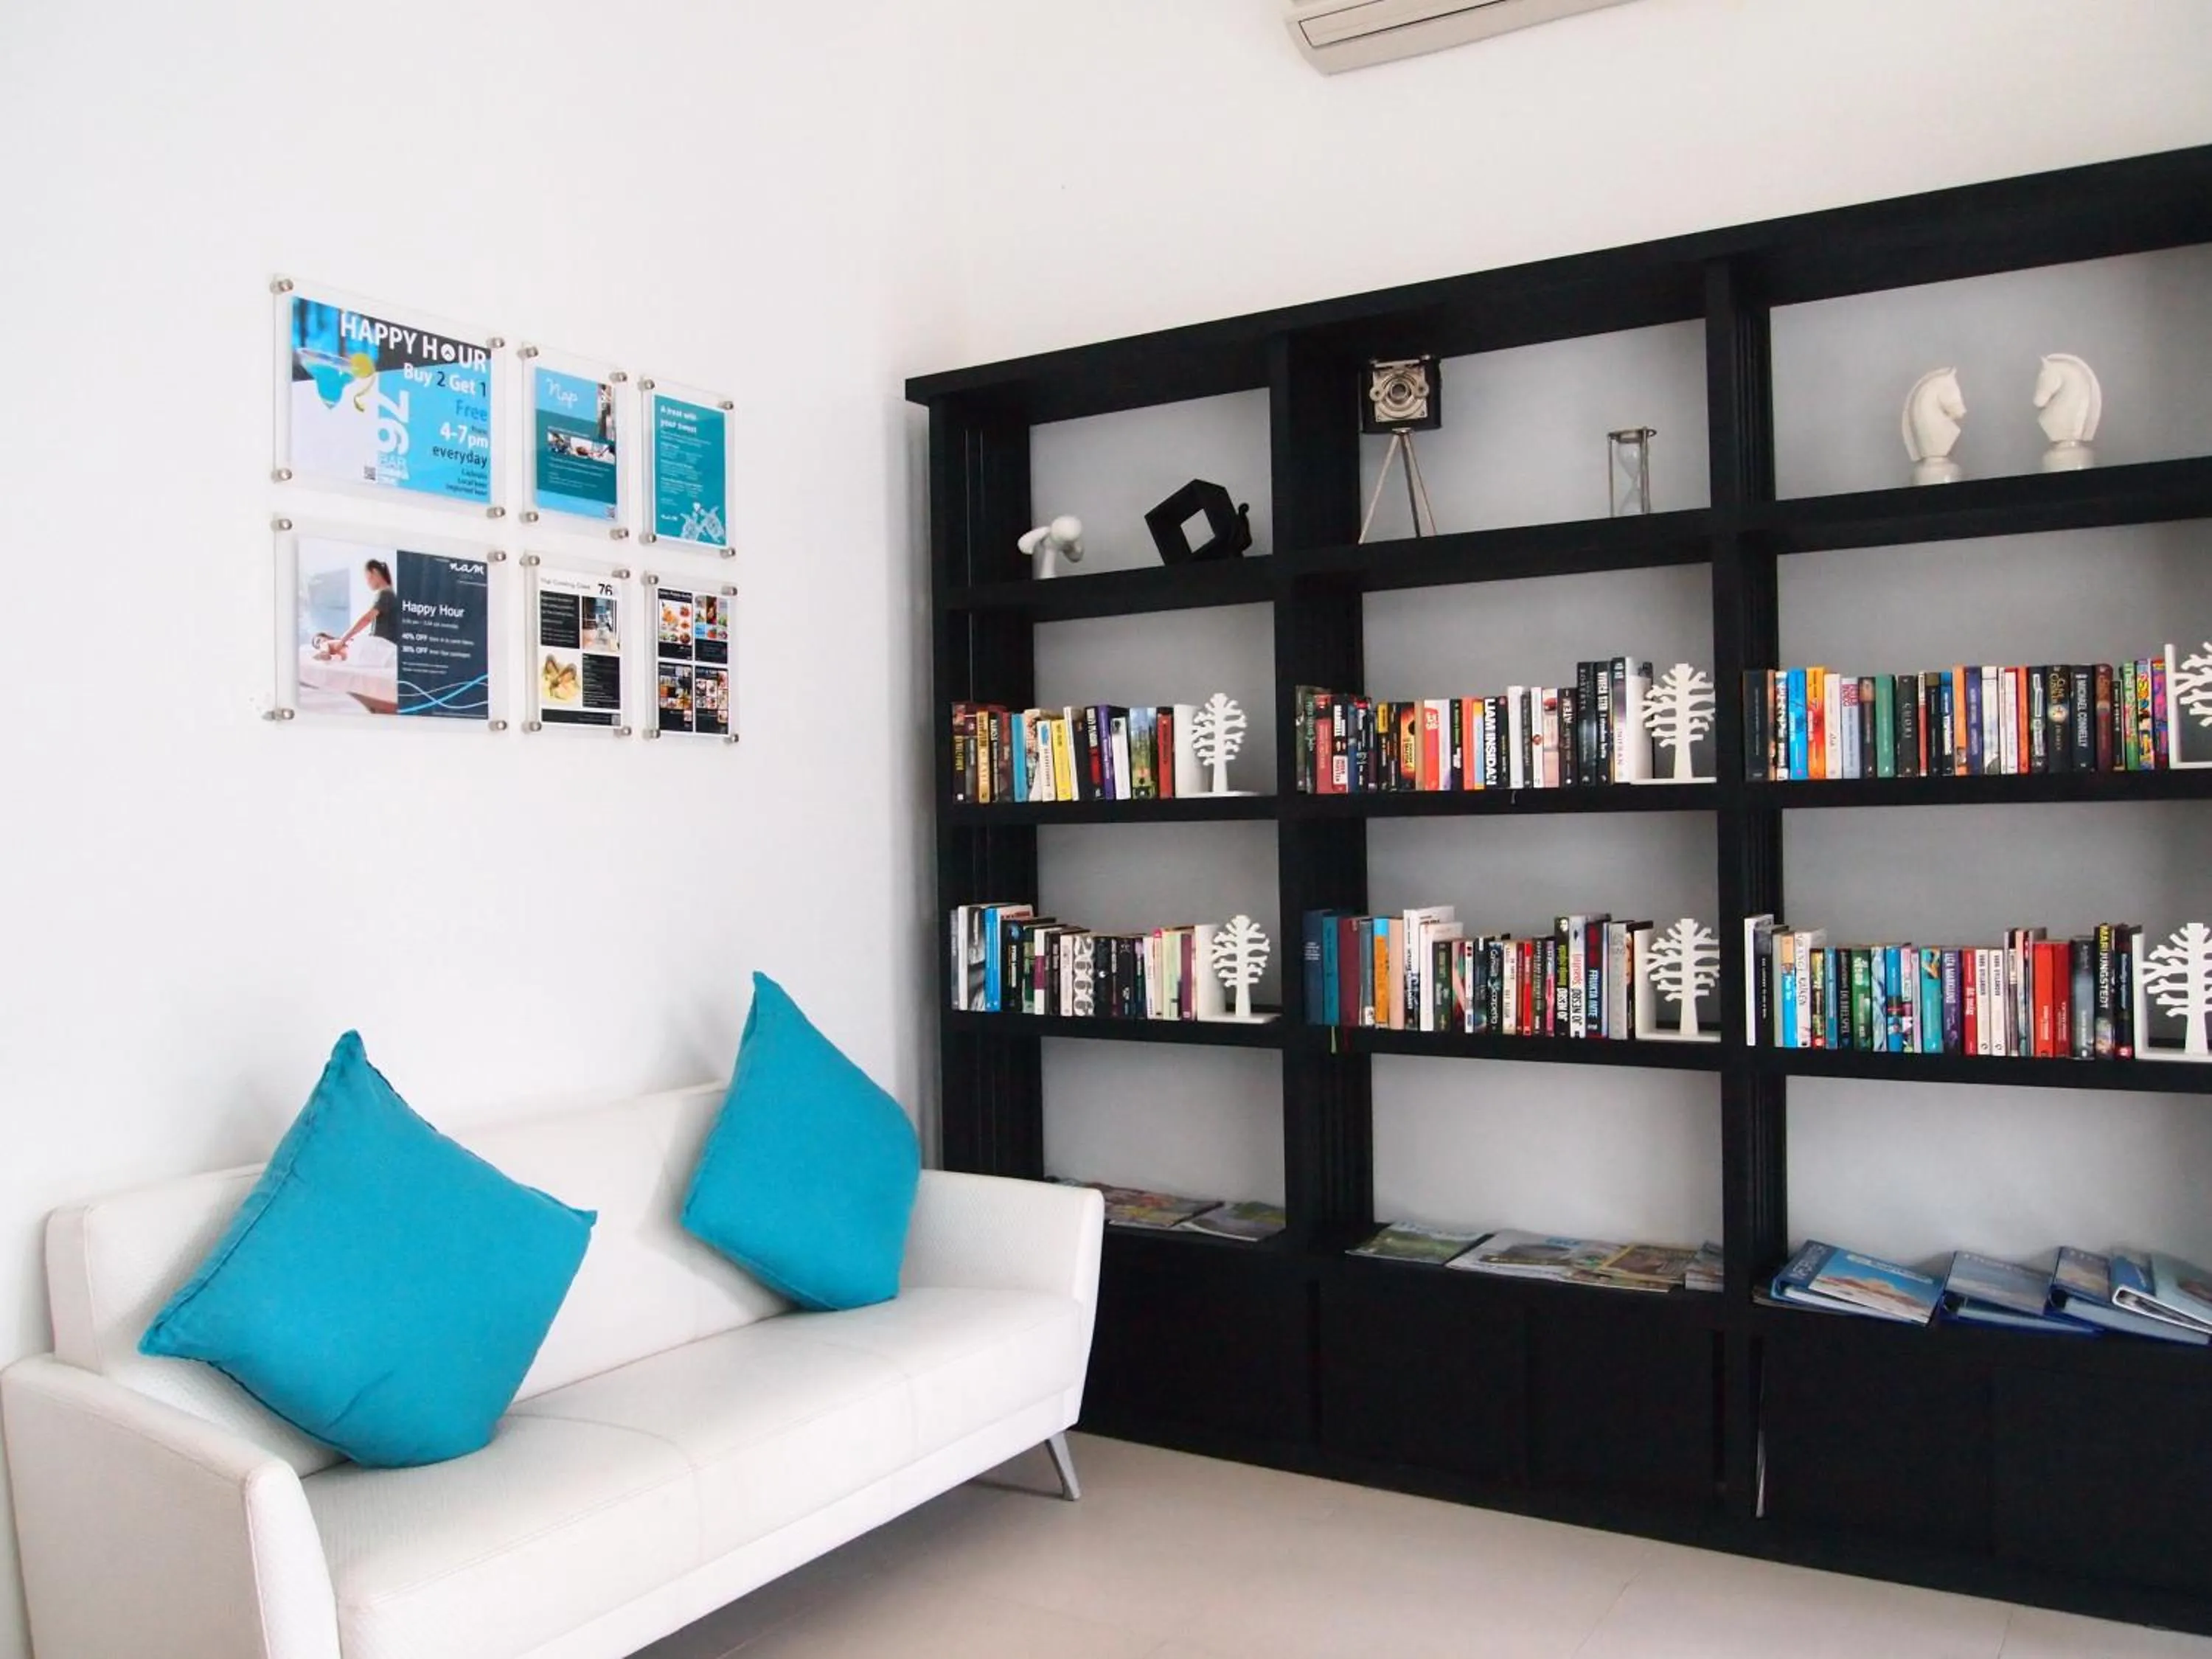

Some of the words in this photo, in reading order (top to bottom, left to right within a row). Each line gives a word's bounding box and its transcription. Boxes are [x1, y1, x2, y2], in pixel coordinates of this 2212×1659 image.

[340, 310, 417, 355] HAPPY
[422, 335, 487, 374] HOUR
[403, 362, 433, 386] Buy
[436, 371, 446, 387] 2
[448, 375, 476, 395] Get
[480, 382, 487, 397] 1
[455, 399, 488, 422] Free
[439, 421, 489, 449] 4-7pm
[432, 445, 488, 469] everyday
[598, 582, 613, 596] 76
[402, 599, 437, 617] Happy
[439, 605, 465, 618] Hour
[2077, 680, 2088, 712] MICHAEL
[2078, 712, 2089, 748] CONNELLY
[2099, 925, 2110, 952] MARI
[2099, 951, 2110, 1009] JUNGSTEDT
